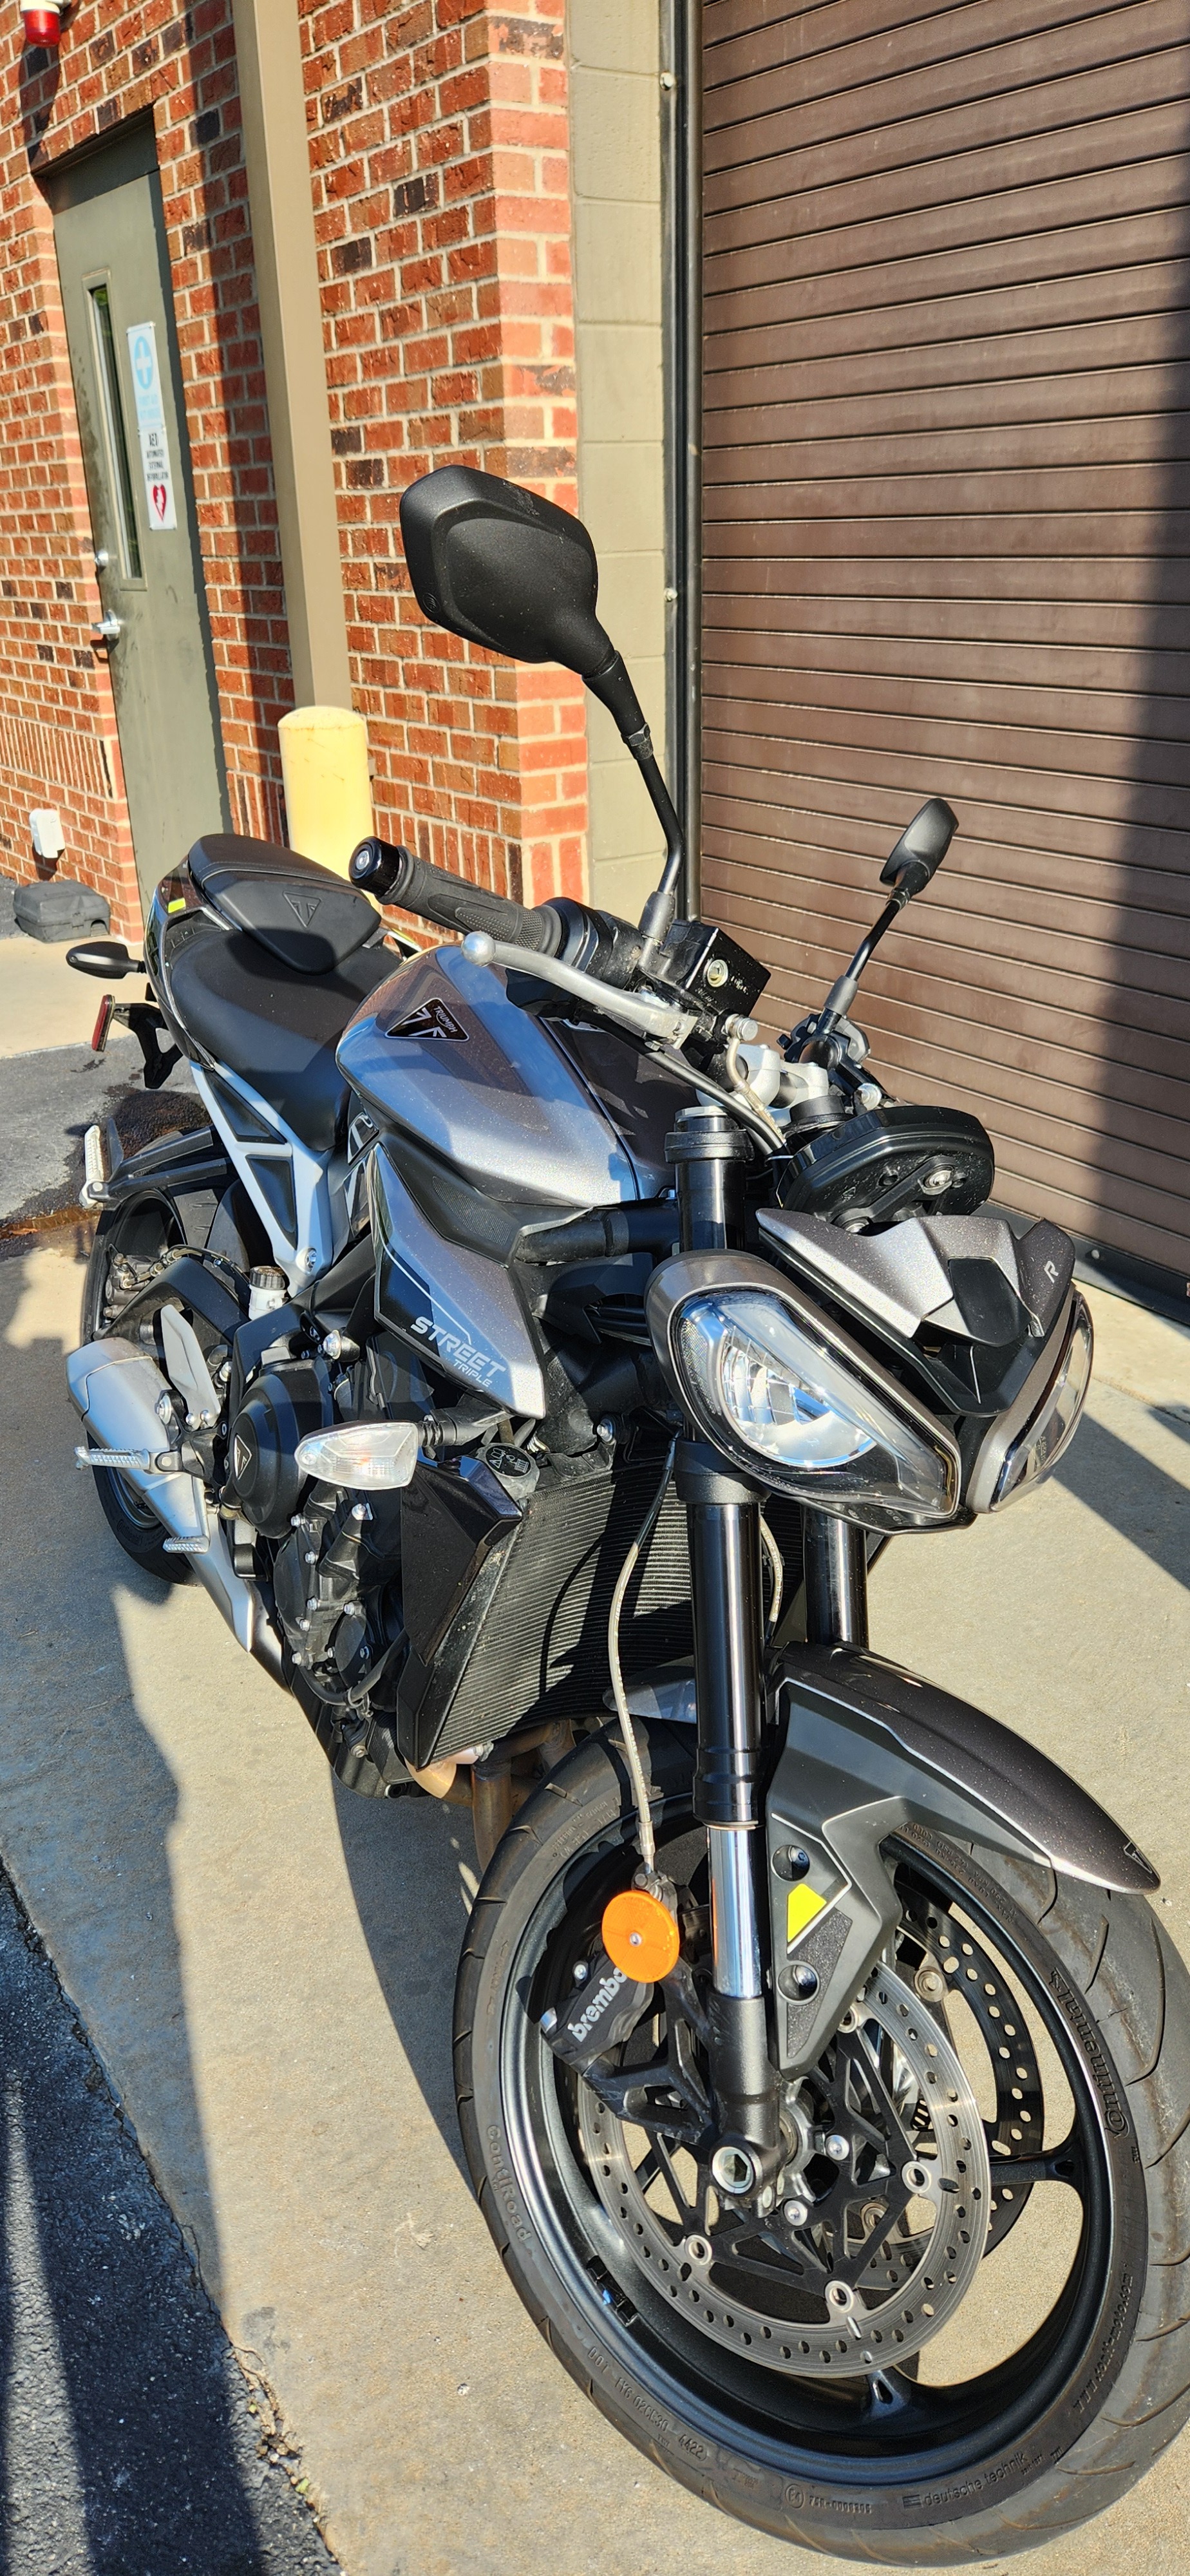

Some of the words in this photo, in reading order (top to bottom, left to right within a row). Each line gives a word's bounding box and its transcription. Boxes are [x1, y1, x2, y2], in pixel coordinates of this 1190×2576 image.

[433, 1006, 458, 1032] TRIUMPH
[1044, 1260, 1059, 1283] R
[410, 1316, 506, 1377] STREET
[453, 1359, 493, 1387] TRIPLE
[567, 1967, 628, 2043] brembo
[1056, 1990, 1130, 2138] Continental
[486, 2123, 533, 2243] ContiRoad
[586, 2345, 611, 2374] DOT
[924, 2477, 984, 2506] deutsche
[982, 2449, 1028, 2485] technik
